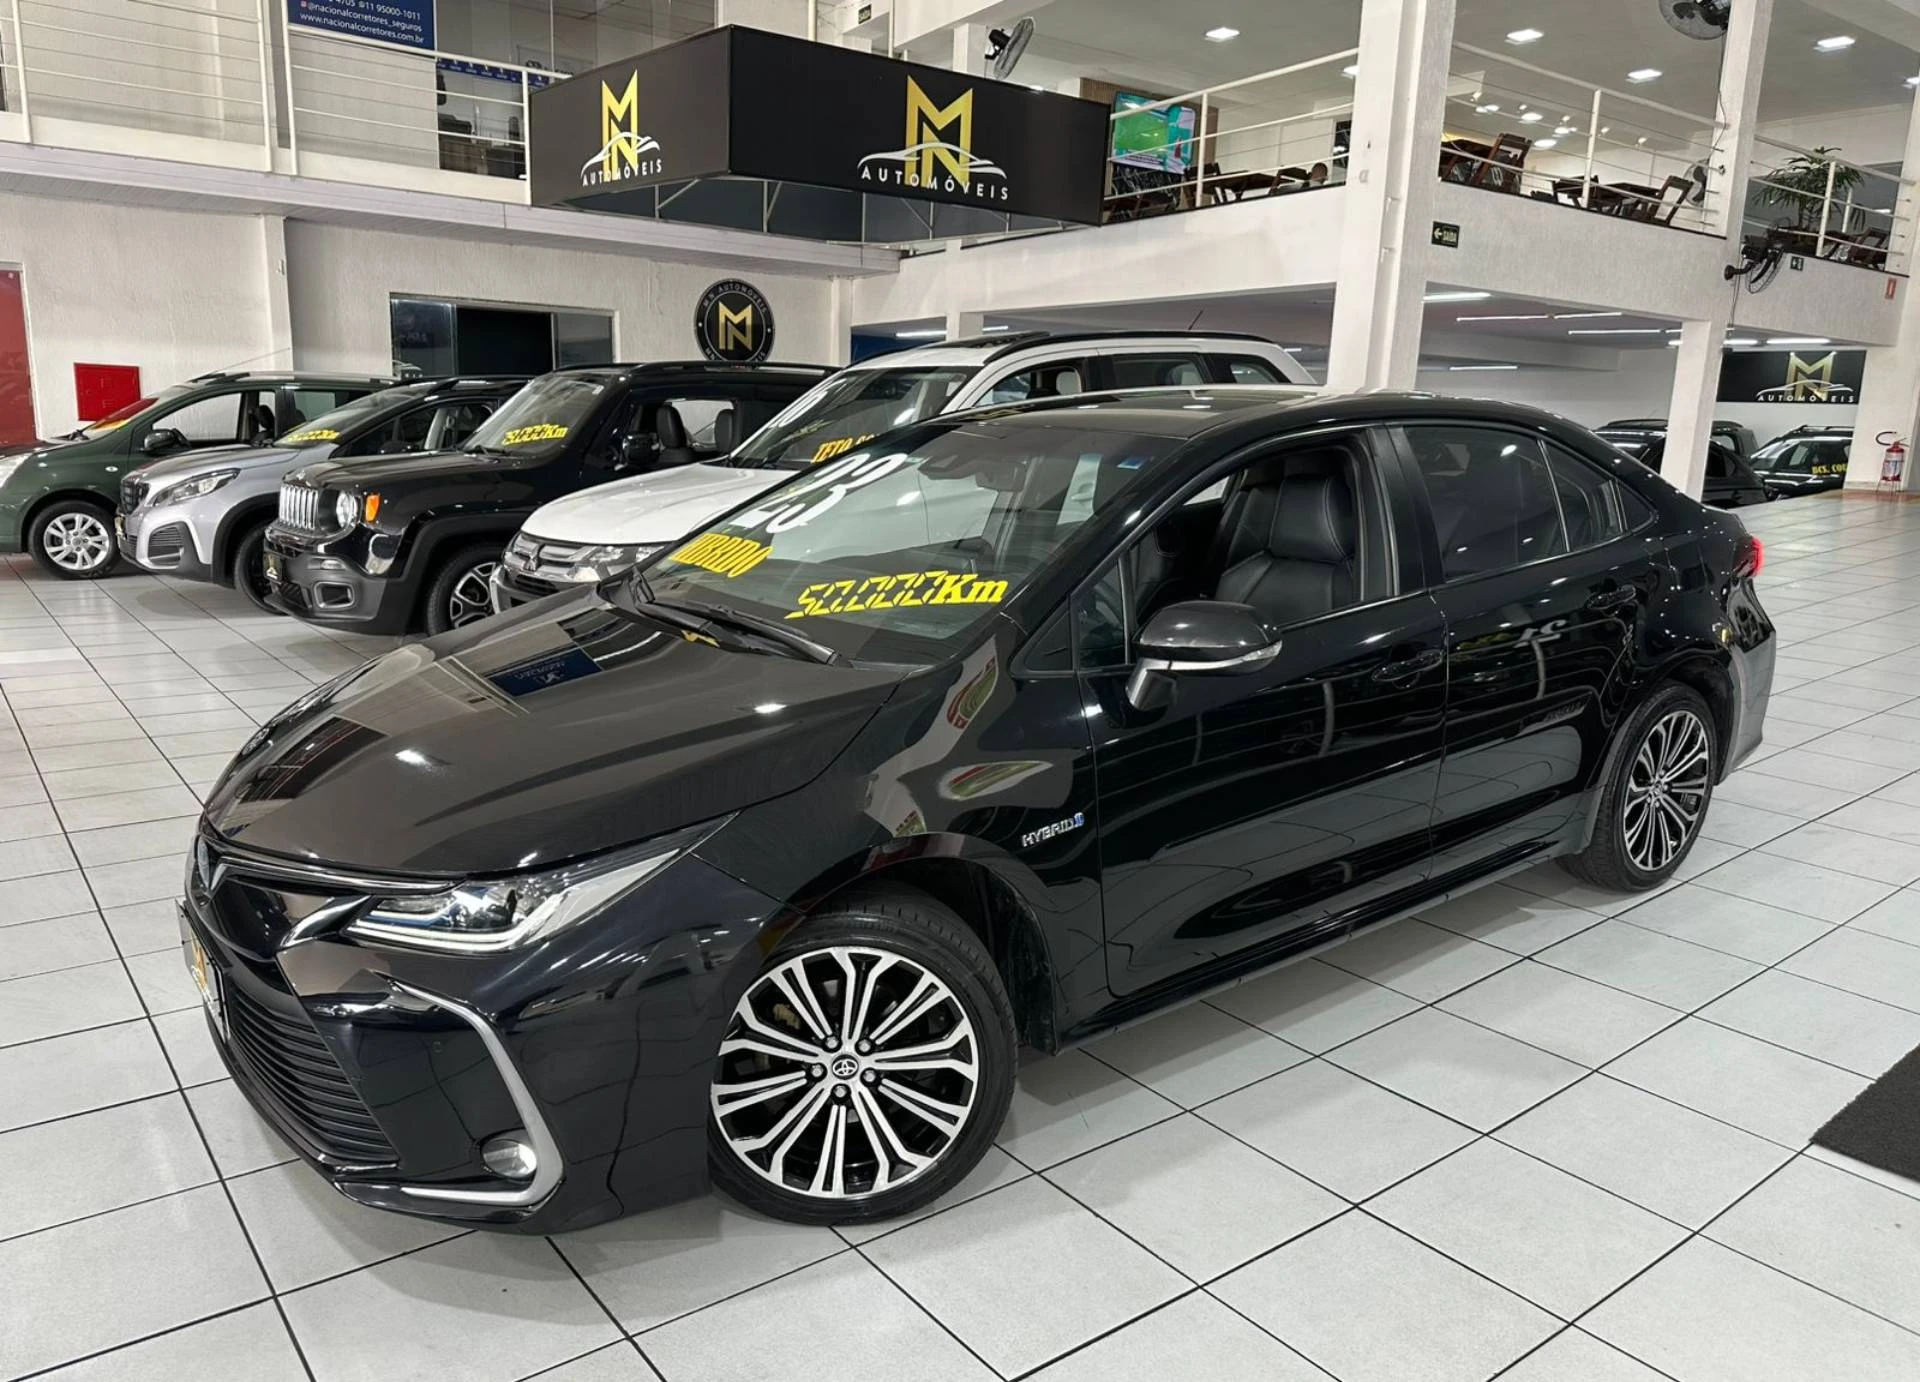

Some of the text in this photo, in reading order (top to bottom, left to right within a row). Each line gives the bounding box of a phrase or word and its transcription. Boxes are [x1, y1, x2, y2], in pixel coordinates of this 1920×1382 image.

[376, 4, 420, 20] 95000-1011
[300, 13, 424, 43] www.nacionalcorretores.com.br
[582, 158, 663, 188] AUTOMÓVEIS
[861, 165, 1009, 200] AUTOMÓVEIS
[784, 569, 1009, 619] 50.000Km
[1022, 818, 1075, 847] HYBRID
